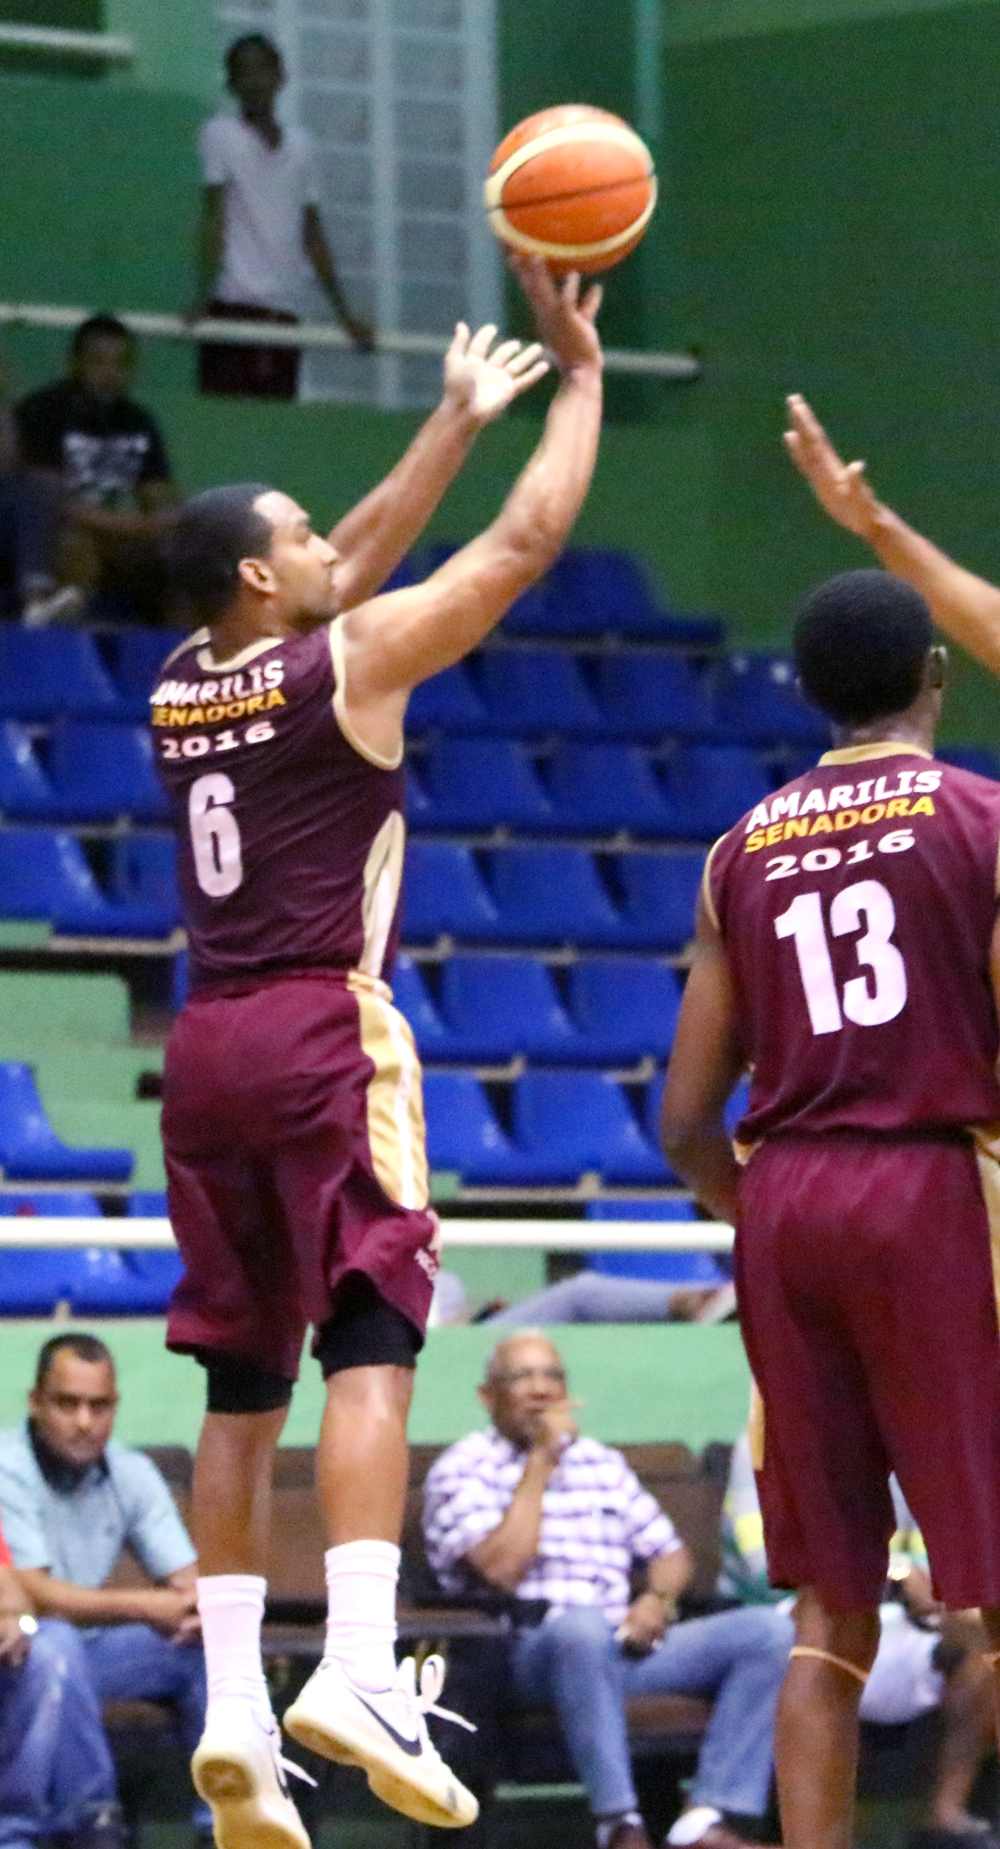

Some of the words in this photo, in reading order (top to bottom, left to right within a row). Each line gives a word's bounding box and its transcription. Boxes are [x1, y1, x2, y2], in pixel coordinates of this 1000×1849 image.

[161, 721, 276, 759] 2016
[745, 771, 942, 833] AMARILIS
[745, 796, 935, 853] SENADORA
[189, 772, 243, 898] 6
[765, 829, 915, 881] 2016
[774, 879, 908, 1035] 13
